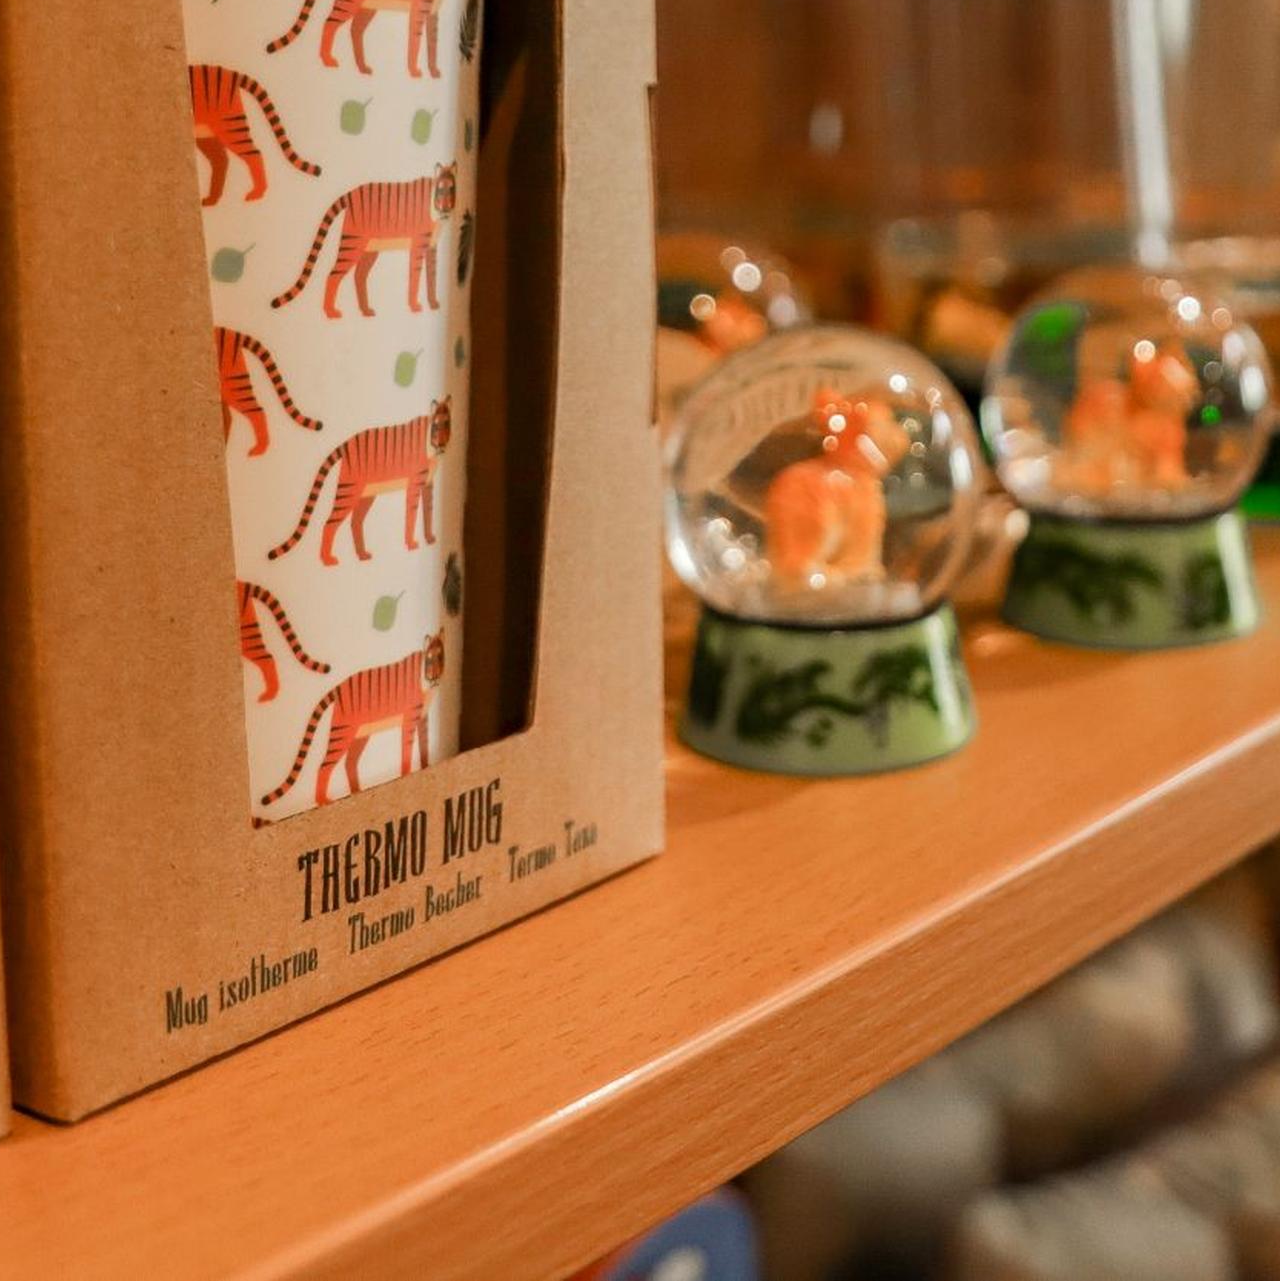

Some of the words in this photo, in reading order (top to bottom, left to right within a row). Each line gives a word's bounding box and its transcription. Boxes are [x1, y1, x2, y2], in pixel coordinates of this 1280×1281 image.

[297, 808, 428, 922] THERMO
[441, 777, 504, 865] MUG
[165, 984, 209, 1034] Mug
[218, 943, 319, 1012] isotherme
[348, 904, 416, 955] Thermo
[424, 871, 484, 922] Becher
[508, 844, 557, 883] Termo
